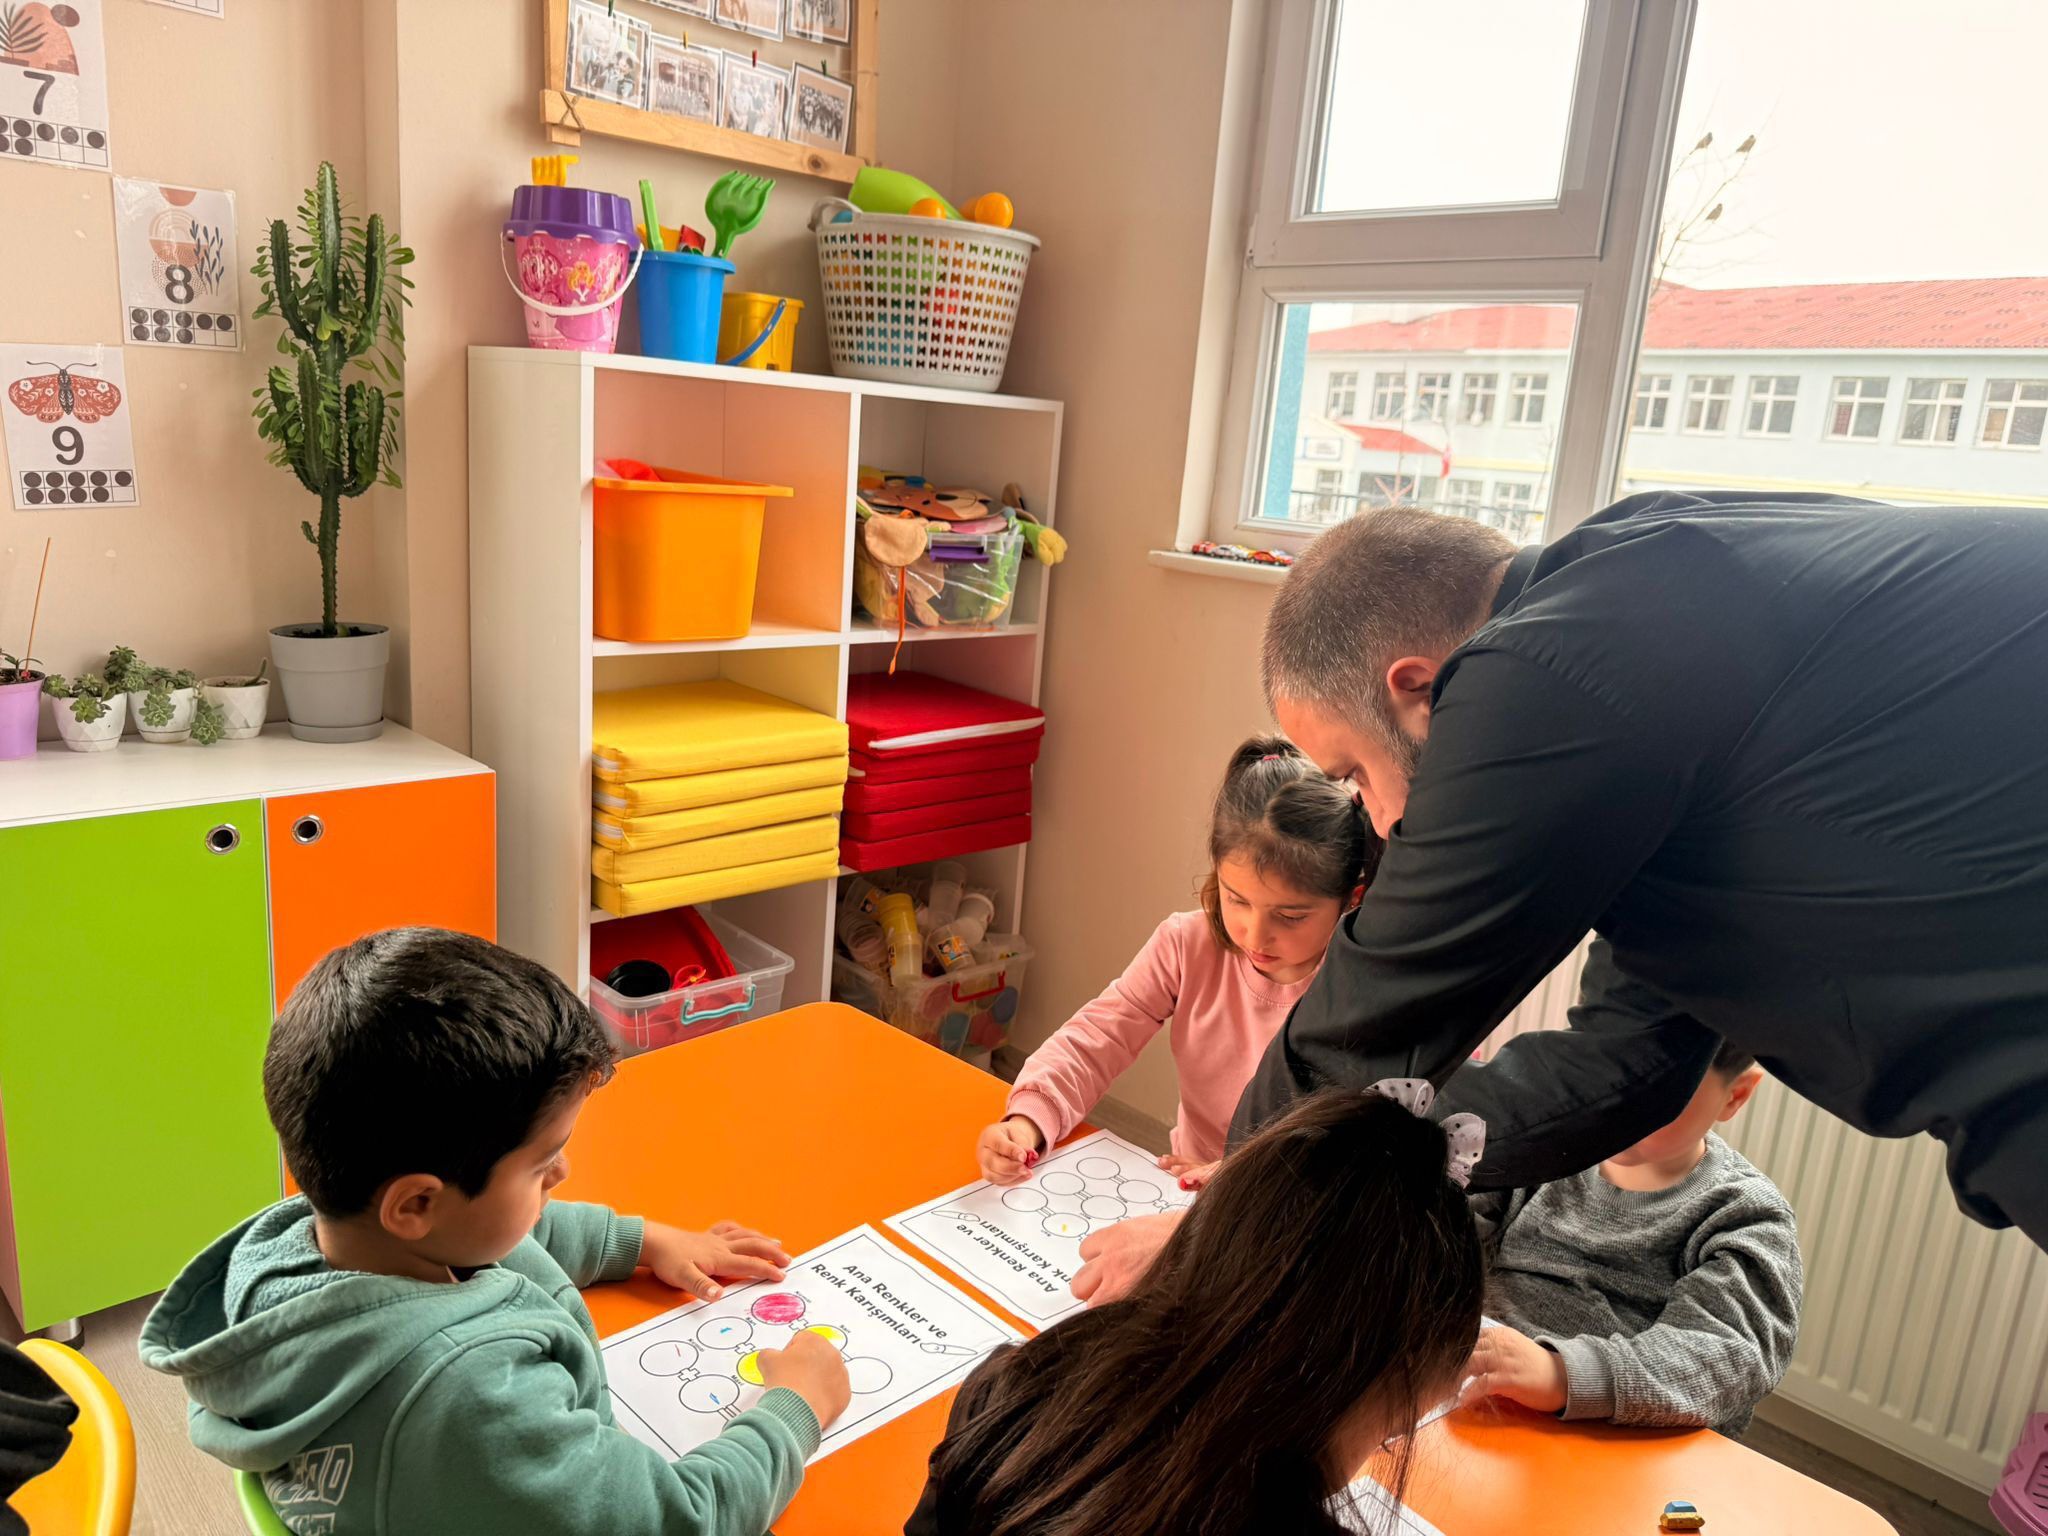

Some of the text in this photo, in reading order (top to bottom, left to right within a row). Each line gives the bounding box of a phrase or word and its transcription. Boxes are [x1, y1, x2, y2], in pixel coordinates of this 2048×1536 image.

[23, 70, 56, 116] 7
[164, 264, 195, 305] 8
[51, 425, 85, 466] 9
[956, 1224, 1059, 1293] Ana Renkler ve
[979, 1220, 1072, 1285] nk Karışımları
[811, 1263, 921, 1344] Renk Karışımları
[843, 1265, 948, 1339] Ana Renkler ve
